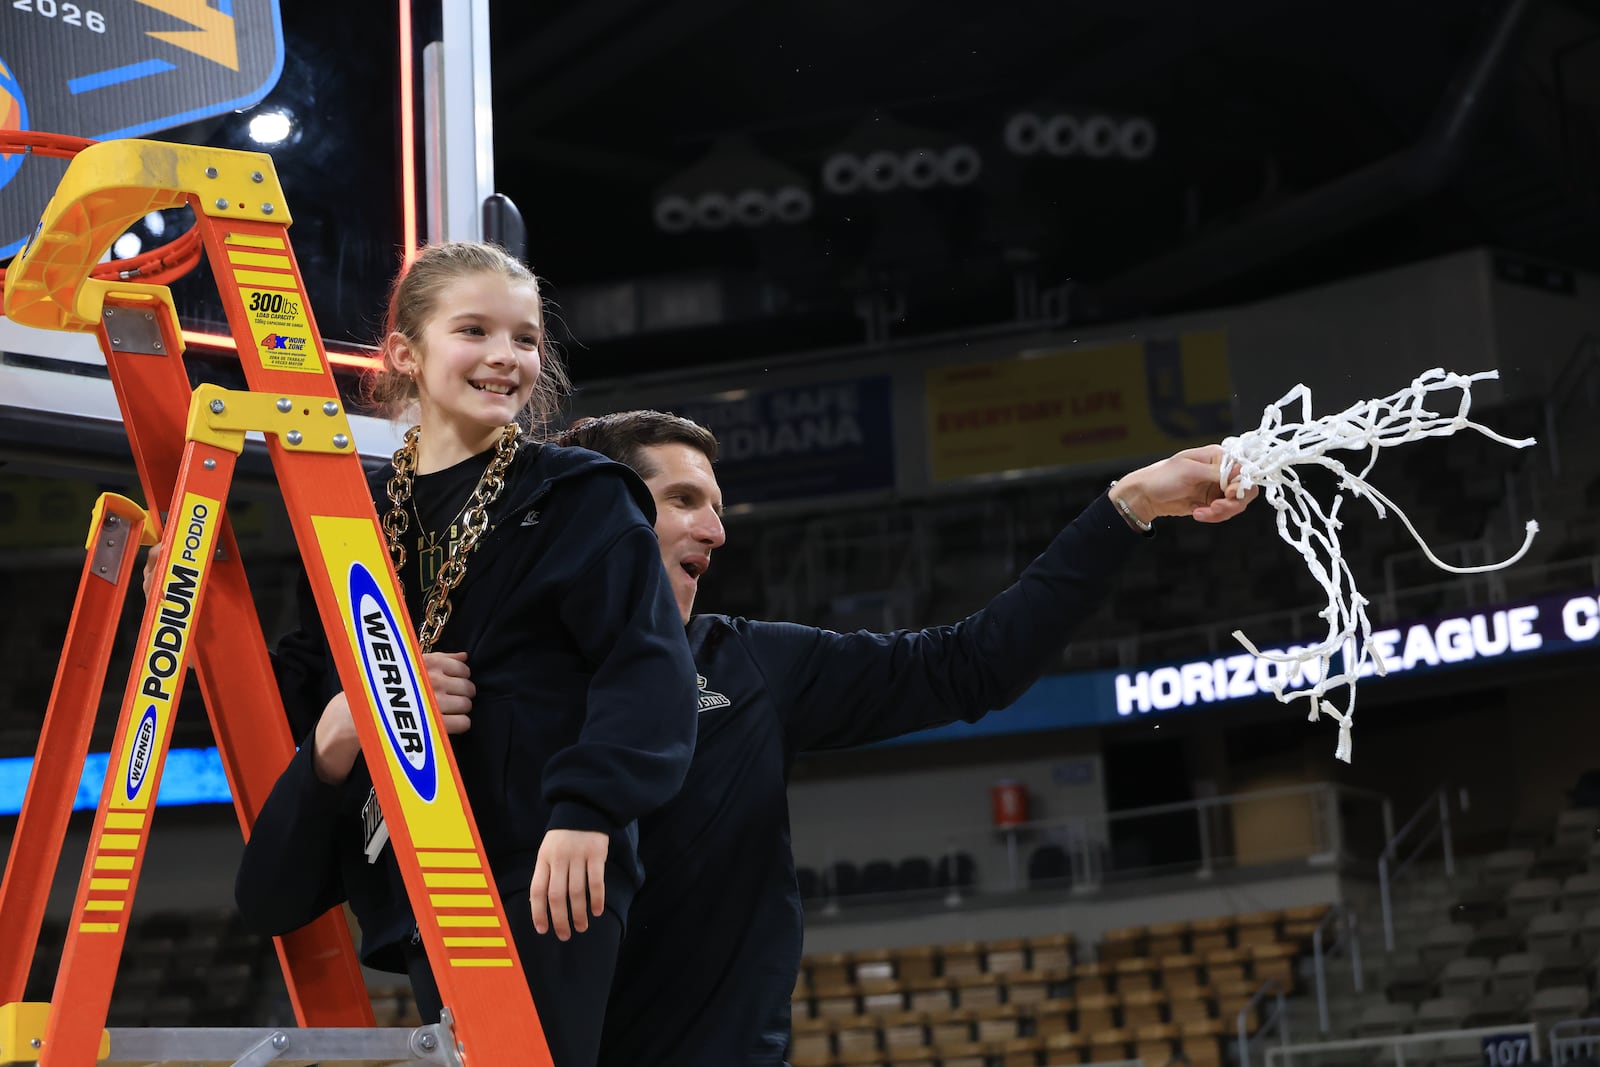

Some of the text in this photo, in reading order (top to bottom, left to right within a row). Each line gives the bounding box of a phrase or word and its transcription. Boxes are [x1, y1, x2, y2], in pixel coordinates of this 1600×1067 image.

[270, 313, 296, 321] CAPACITY
[261, 333, 306, 350] 4X WORK
[288, 343, 303, 351] ZONE
[938, 390, 1125, 433] EVERYDAY LIFE
[142, 504, 208, 701] PODIUM PODIO
[1115, 595, 1600, 716] HORIZON LEAGUE C
[363, 611, 424, 754] WERNER
[699, 695, 729, 708] STATE
[131, 721, 152, 782] WERNER
[1484, 1038, 1529, 1067] 107
